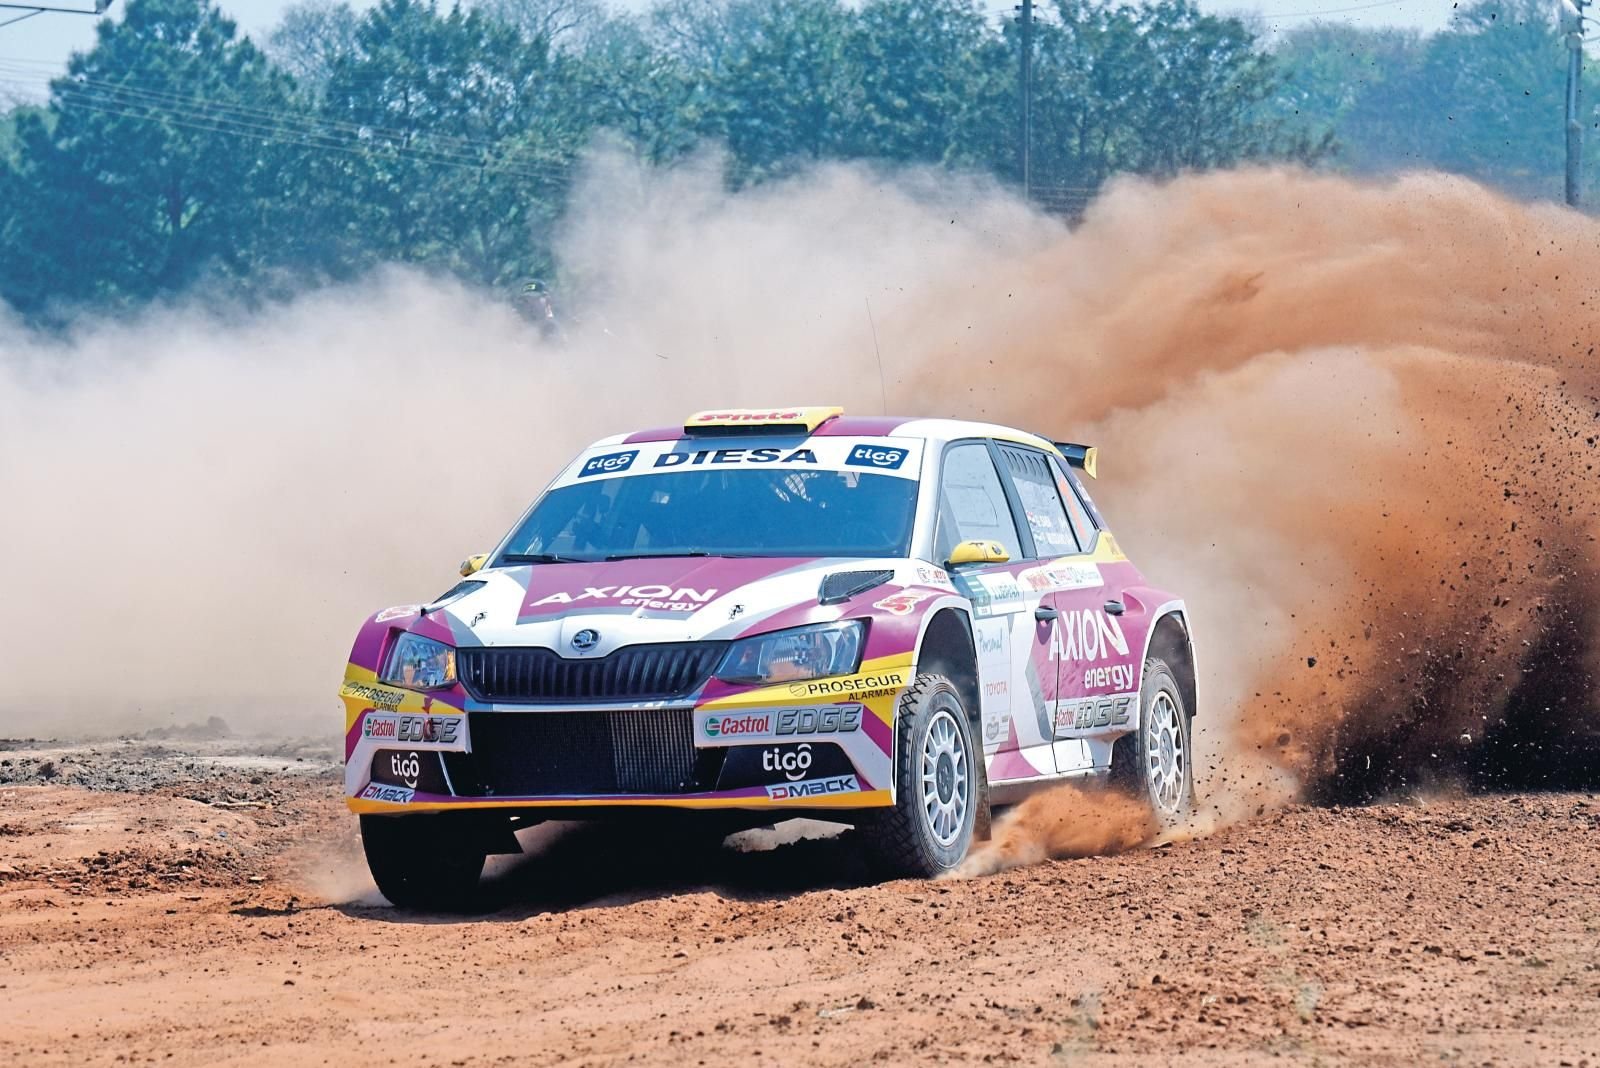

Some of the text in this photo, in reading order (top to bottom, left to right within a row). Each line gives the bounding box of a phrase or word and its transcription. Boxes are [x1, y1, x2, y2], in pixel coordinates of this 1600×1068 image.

[588, 453, 632, 470] tigo
[652, 448, 818, 467] DIESA
[854, 448, 902, 466] tigo
[529, 585, 718, 606] AXION
[620, 598, 702, 611] energy
[1049, 608, 1129, 662] AXION
[808, 674, 902, 695] PROSEGUR
[1084, 664, 1133, 691] energy
[354, 684, 405, 704] PROSEGUR
[848, 688, 897, 702] ALARMAS
[986, 681, 1008, 696] TOYOTA
[373, 701, 398, 713] ALARMAS
[1075, 697, 1131, 730] EDGE
[371, 716, 461, 743] Castrol EDGE
[721, 707, 862, 736] Castrol EDGE
[391, 752, 420, 788] tigo
[763, 743, 812, 781] tigo
